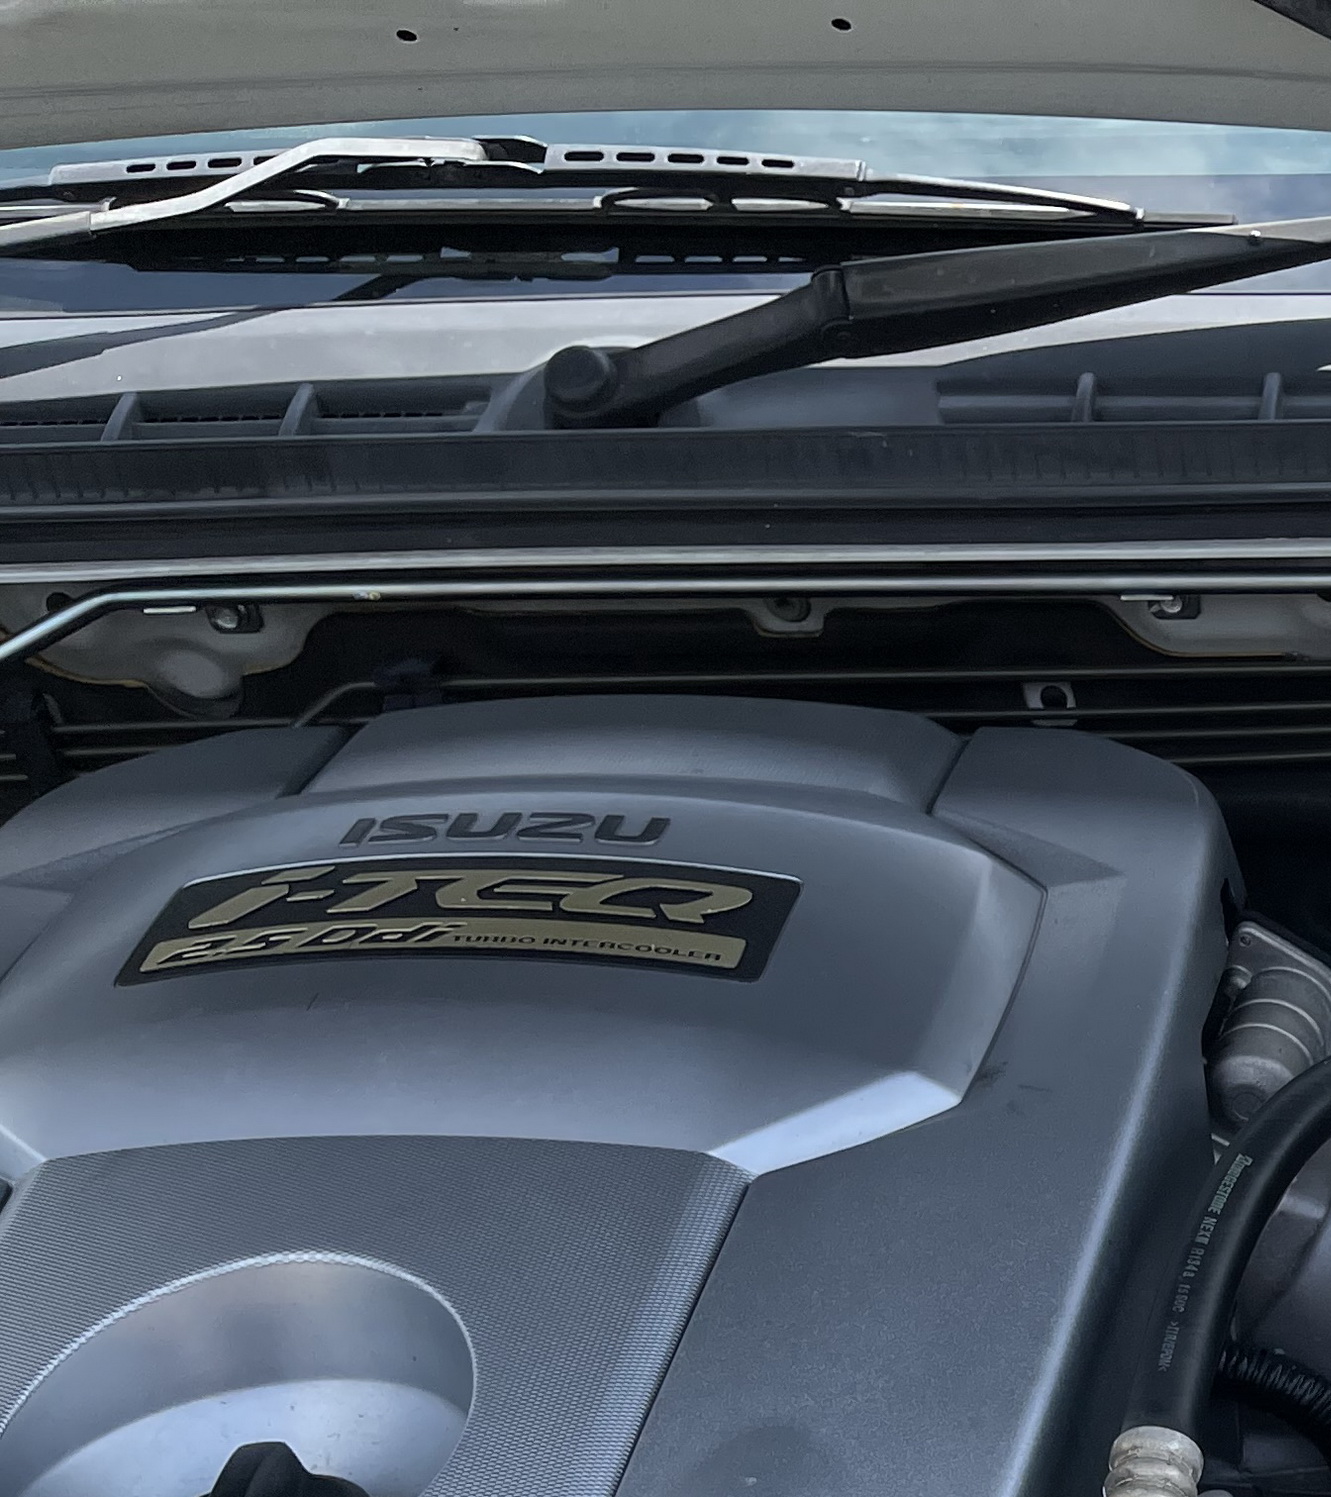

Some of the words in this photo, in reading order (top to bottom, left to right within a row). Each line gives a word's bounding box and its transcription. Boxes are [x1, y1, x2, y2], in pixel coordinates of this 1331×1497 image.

[338, 813, 671, 847] ISUZU
[454, 934, 536, 946] TURBO
[544, 937, 722, 962] INTERCOOLER
